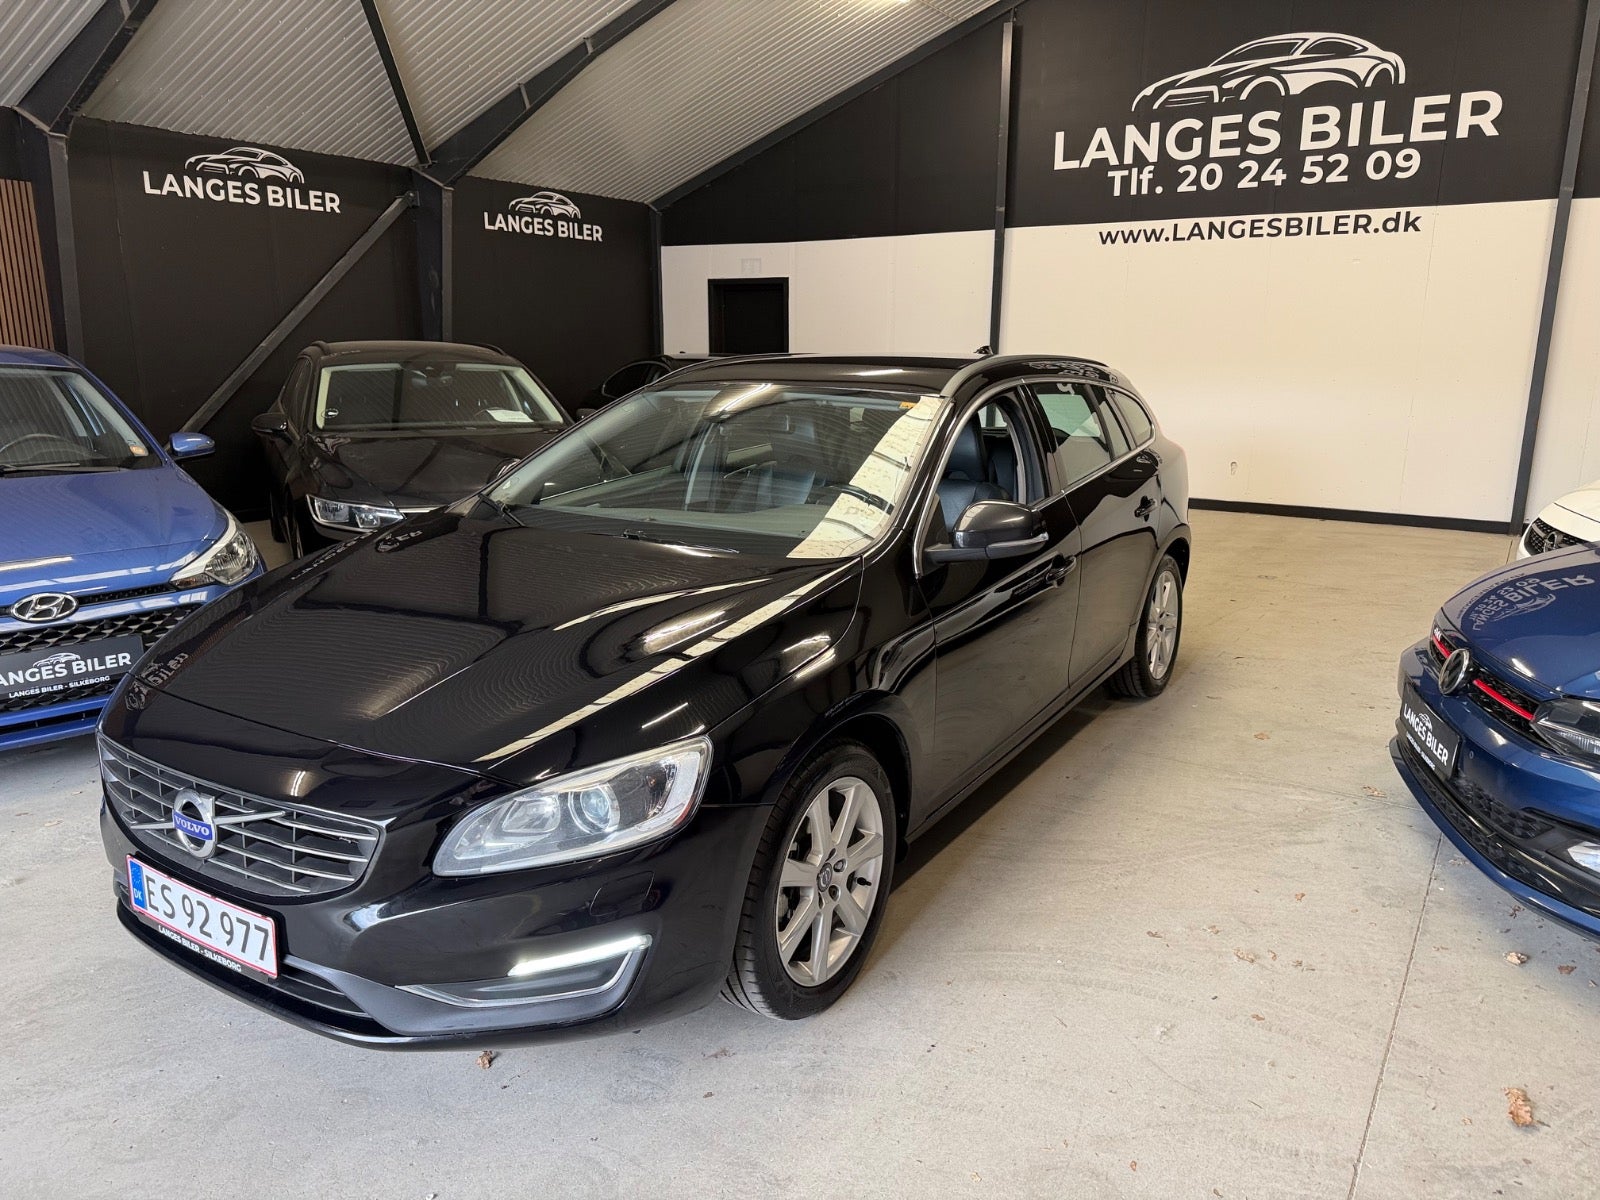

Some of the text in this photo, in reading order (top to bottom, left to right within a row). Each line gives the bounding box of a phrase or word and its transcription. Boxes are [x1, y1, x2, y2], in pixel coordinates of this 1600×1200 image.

[1054, 90, 1503, 171] LANGES BILER
[1107, 148, 1421, 197] Tlf. 20 24 52 09
[143, 171, 341, 213] LANGES BILER
[484, 212, 603, 242] LANGES BILER
[1098, 211, 1422, 245] www.LANGESBILER.dk
[72, 652, 132, 675] BILER
[8, 688, 41, 699] LANGES
[41, 684, 64, 693] BILER
[68, 675, 111, 688] SILKEBORG
[1403, 703, 1427, 741] LANGES
[1425, 731, 1449, 766] BILER
[174, 814, 210, 836] VOLVO
[133, 888, 143, 902] DK
[145, 874, 270, 962] ES 92 977
[203, 949, 242, 973] SILKEBORG
